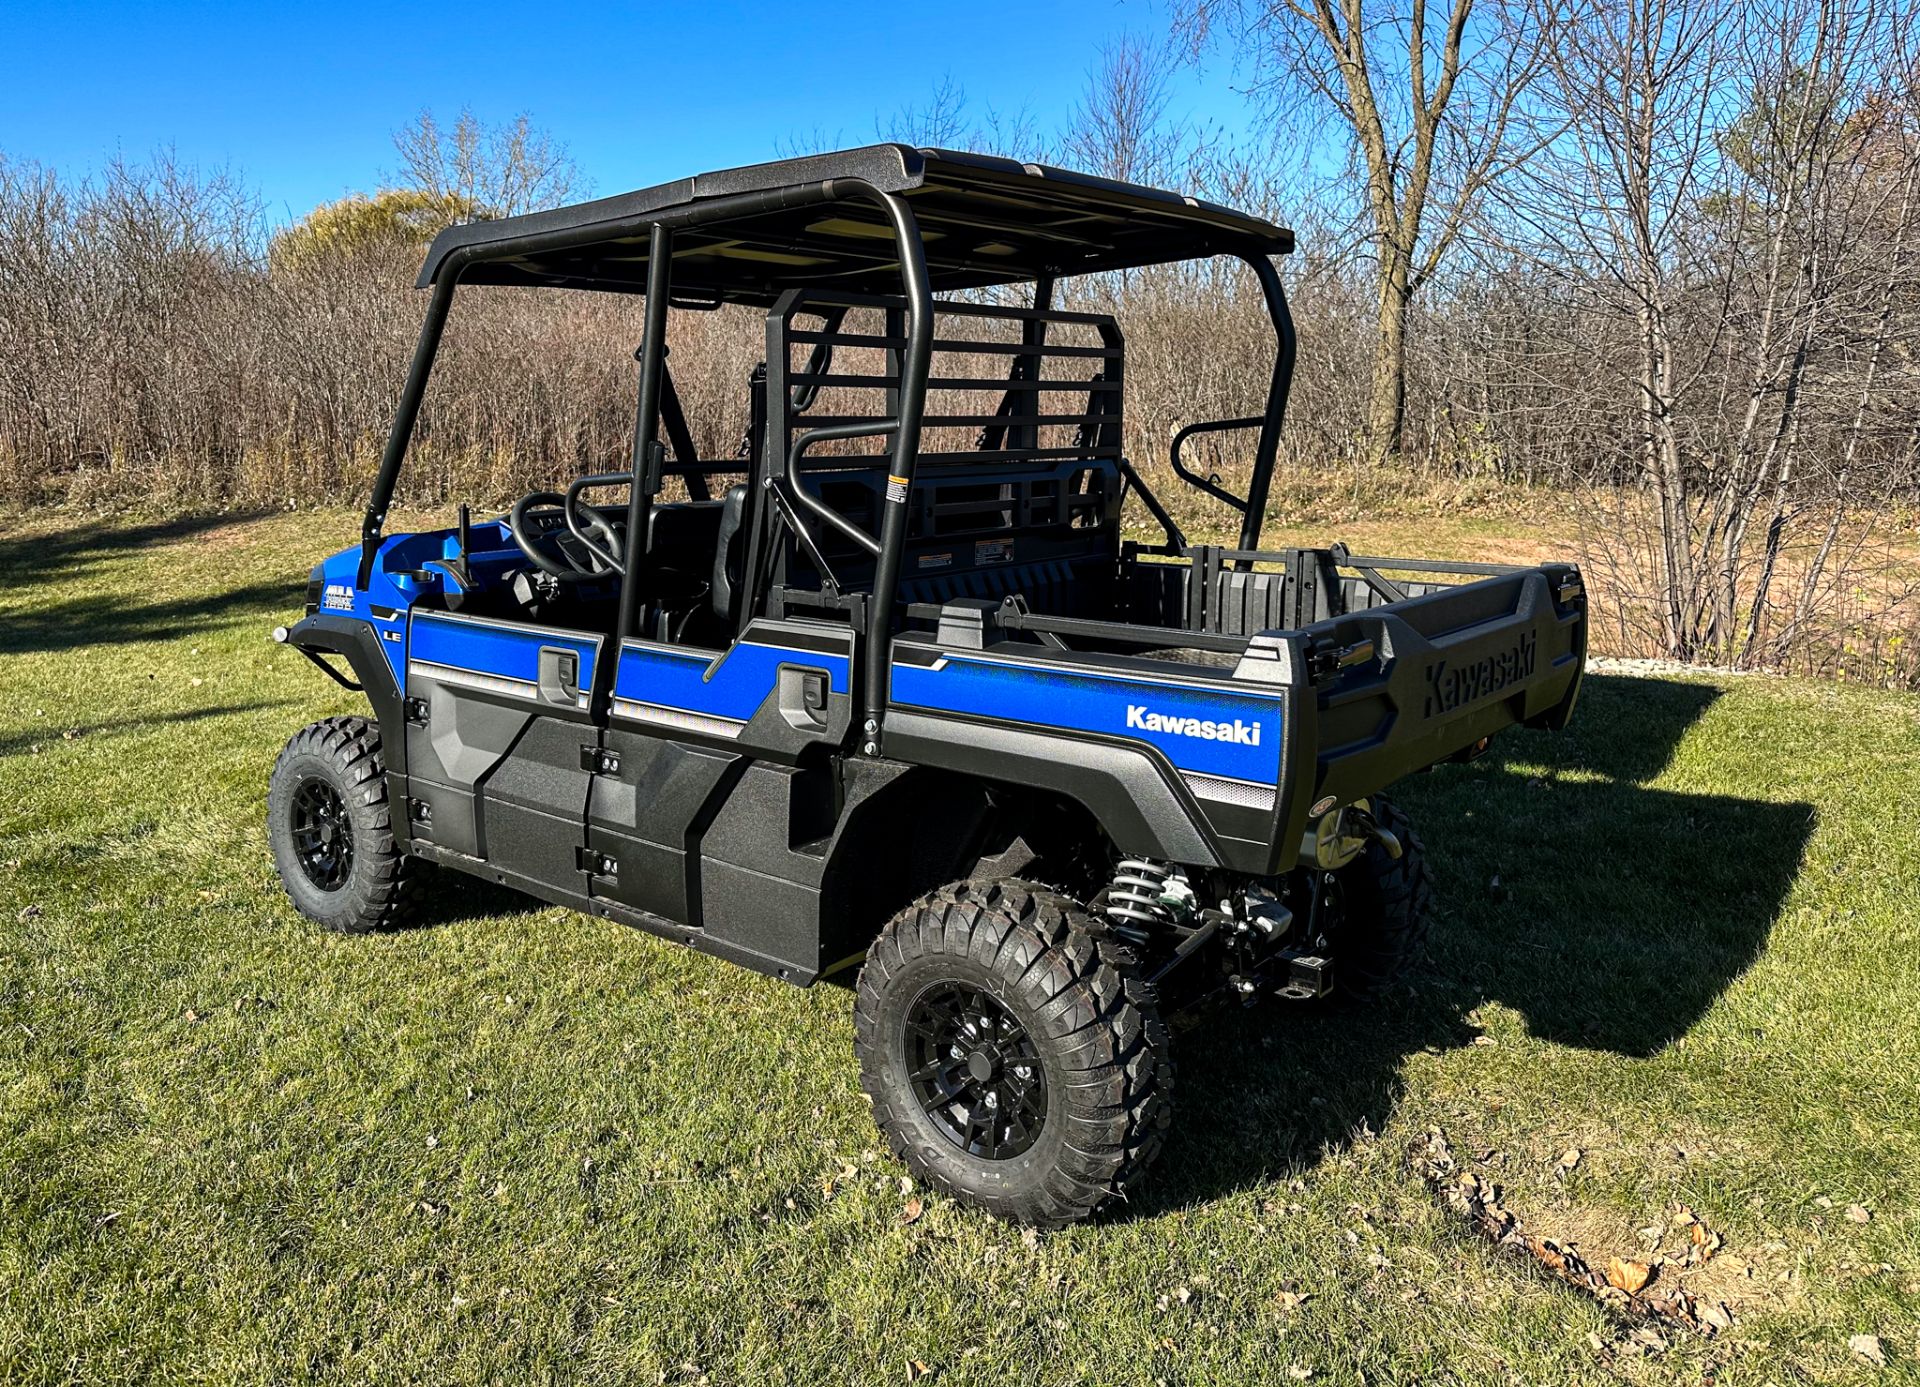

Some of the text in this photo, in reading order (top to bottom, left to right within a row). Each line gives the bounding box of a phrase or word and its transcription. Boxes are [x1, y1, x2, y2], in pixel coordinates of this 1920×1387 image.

[383, 630, 402, 642] LE
[1424, 629, 1536, 719] Kawasaki
[1126, 704, 1261, 746] Kawasaki
